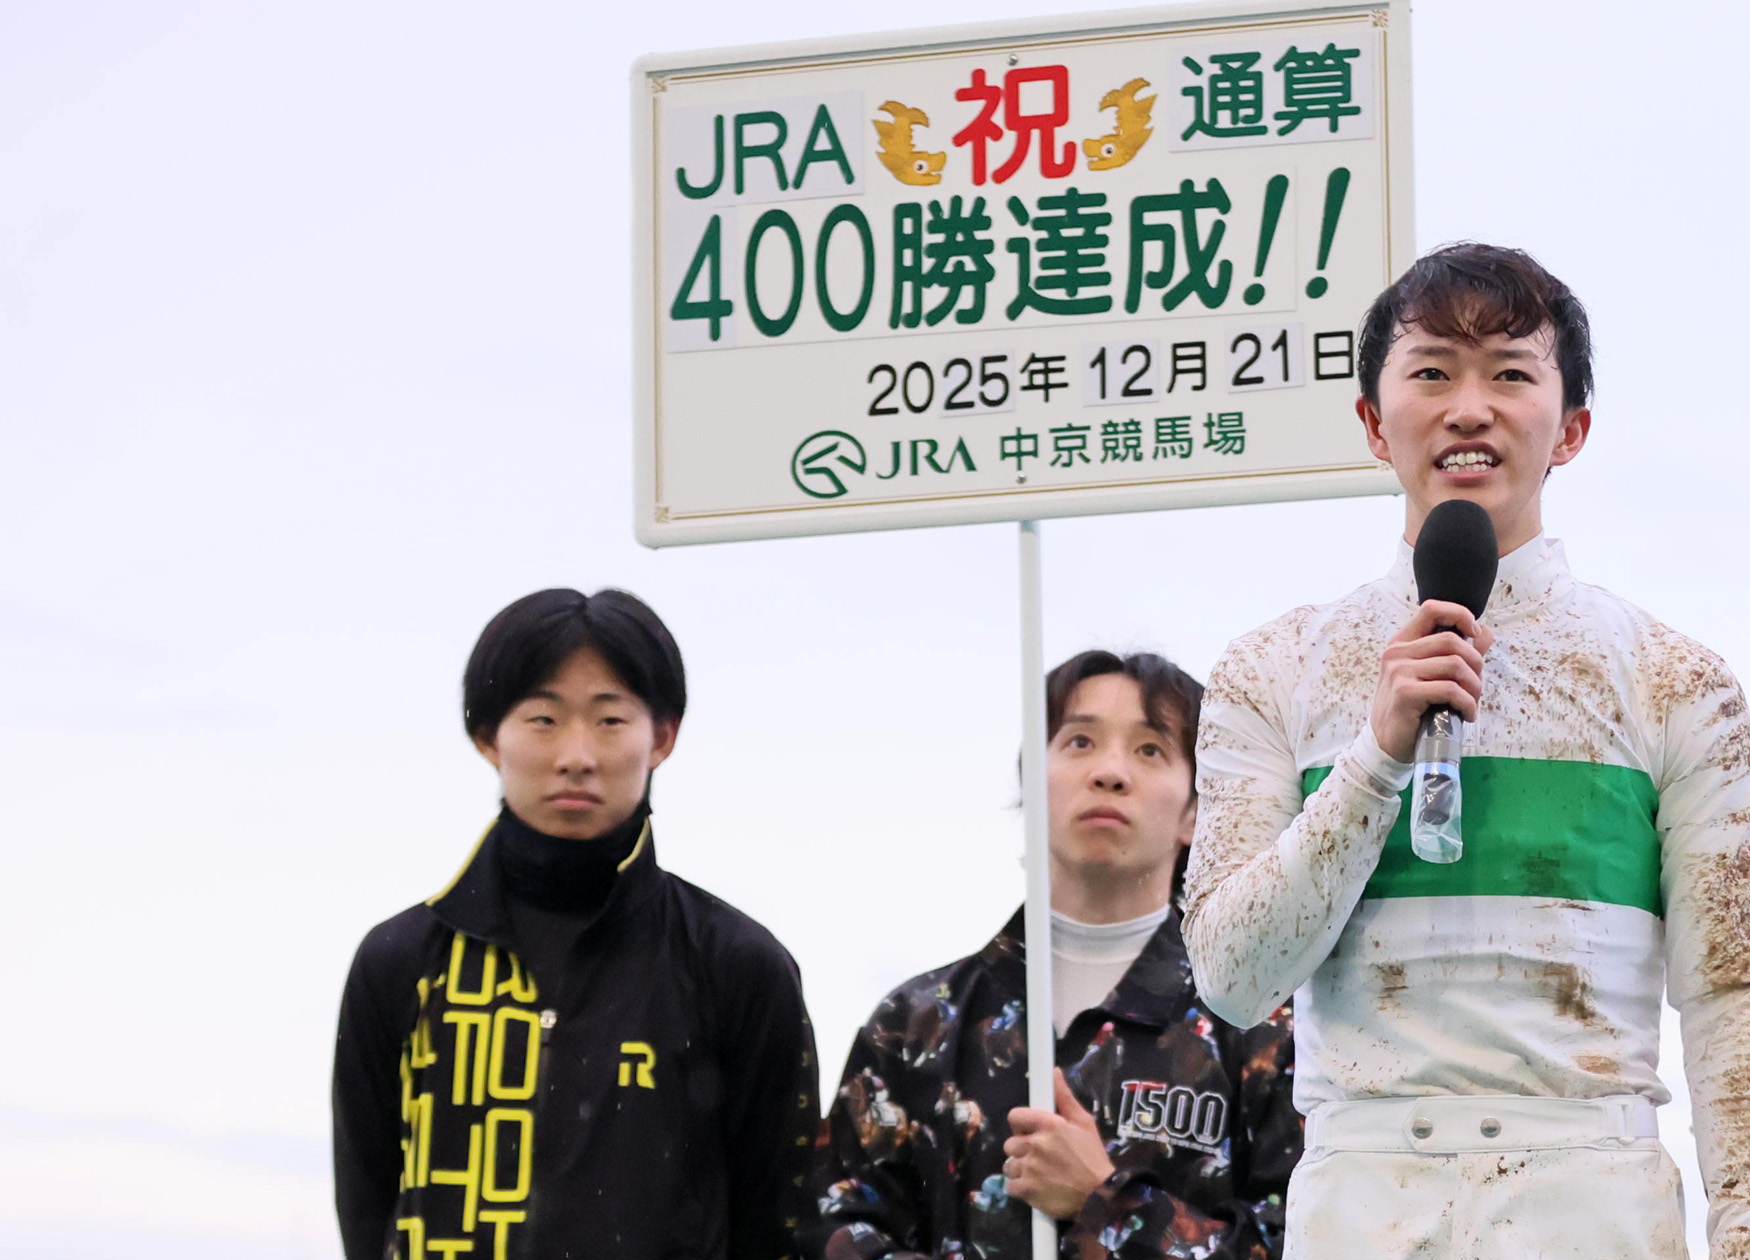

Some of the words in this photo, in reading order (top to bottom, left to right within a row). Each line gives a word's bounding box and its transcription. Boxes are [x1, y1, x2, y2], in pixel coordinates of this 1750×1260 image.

[676, 104, 854, 199] JRA
[952, 65, 1076, 186] 祝
[1182, 43, 1361, 141] 通算
[670, 167, 1350, 341] 400勝達成!!
[876, 435, 978, 479] JRA
[1000, 411, 1246, 472] 中京競馬場
[1118, 1081, 1227, 1144] 1500
